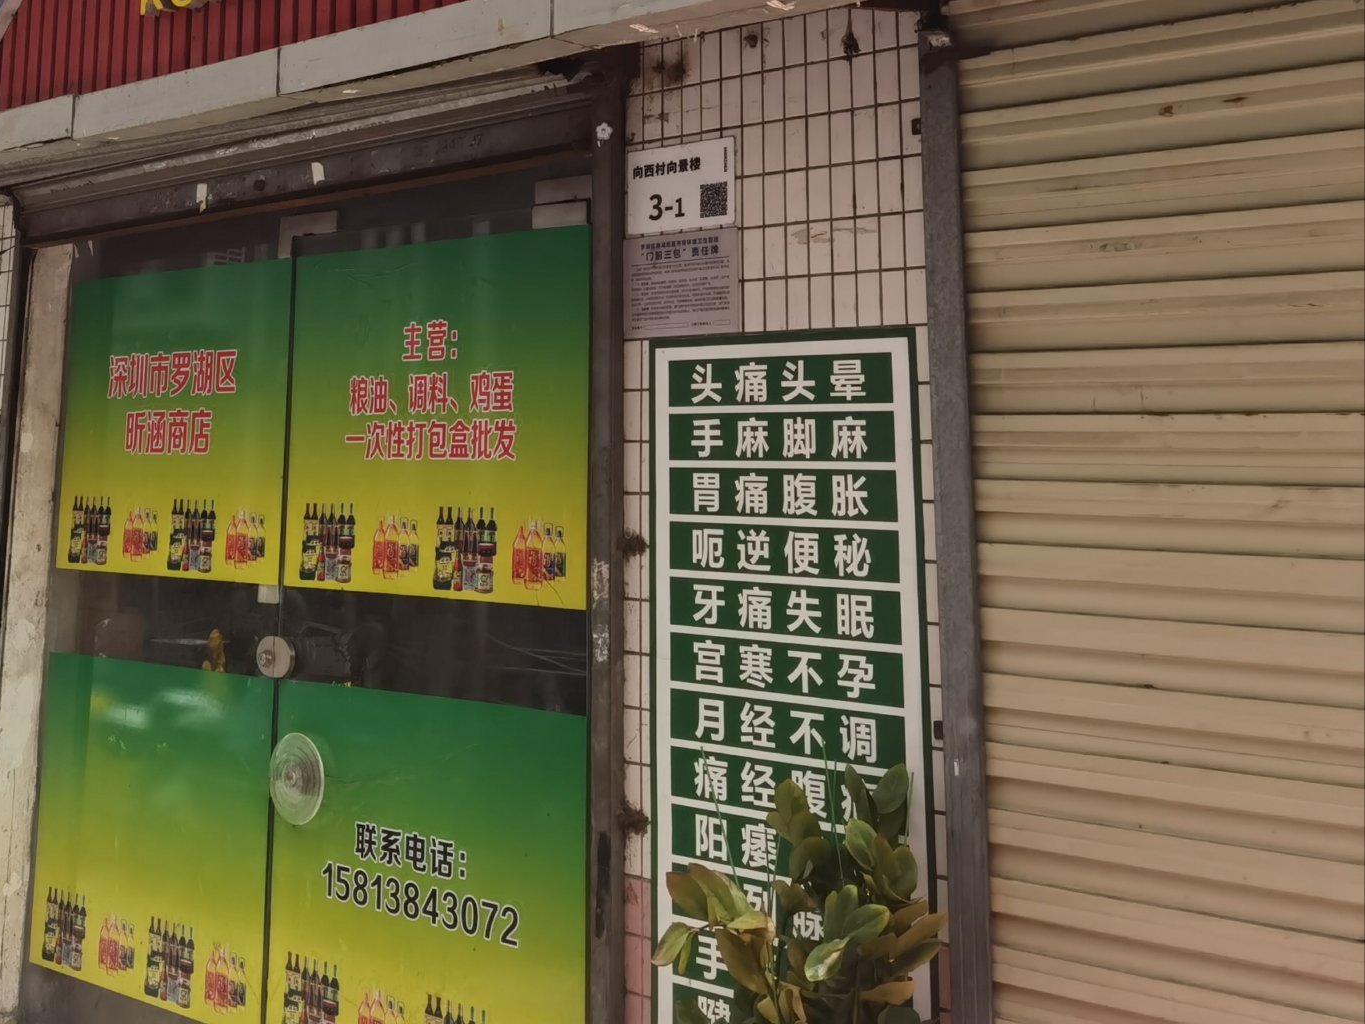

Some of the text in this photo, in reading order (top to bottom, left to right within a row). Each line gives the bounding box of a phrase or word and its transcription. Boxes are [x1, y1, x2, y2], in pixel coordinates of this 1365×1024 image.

[633, 156, 701, 180] 向西村向景楼
[648, 193, 686, 222] 3-1
[107, 349, 238, 400] 深圳市罗湖区
[348, 371, 516, 416] 粮油、调料、鸡蛋
[690, 360, 867, 408] 头痛头晕
[124, 408, 213, 456] 昕涵商店
[345, 419, 518, 461] 一次性打包盒批发
[691, 416, 869, 461] 手麻脚麻
[692, 472, 869, 517] 胃痛腹胀
[692, 528, 871, 579] 呃逆便秘
[693, 583, 875, 639] 牙痛失眠
[693, 639, 877, 700] 宫寒不孕
[694, 689, 878, 764] 月经不调
[694, 755, 879, 822] 痛经腹
[354, 820, 469, 881] 联系电话：
[321, 861, 520, 950] 15813843072
